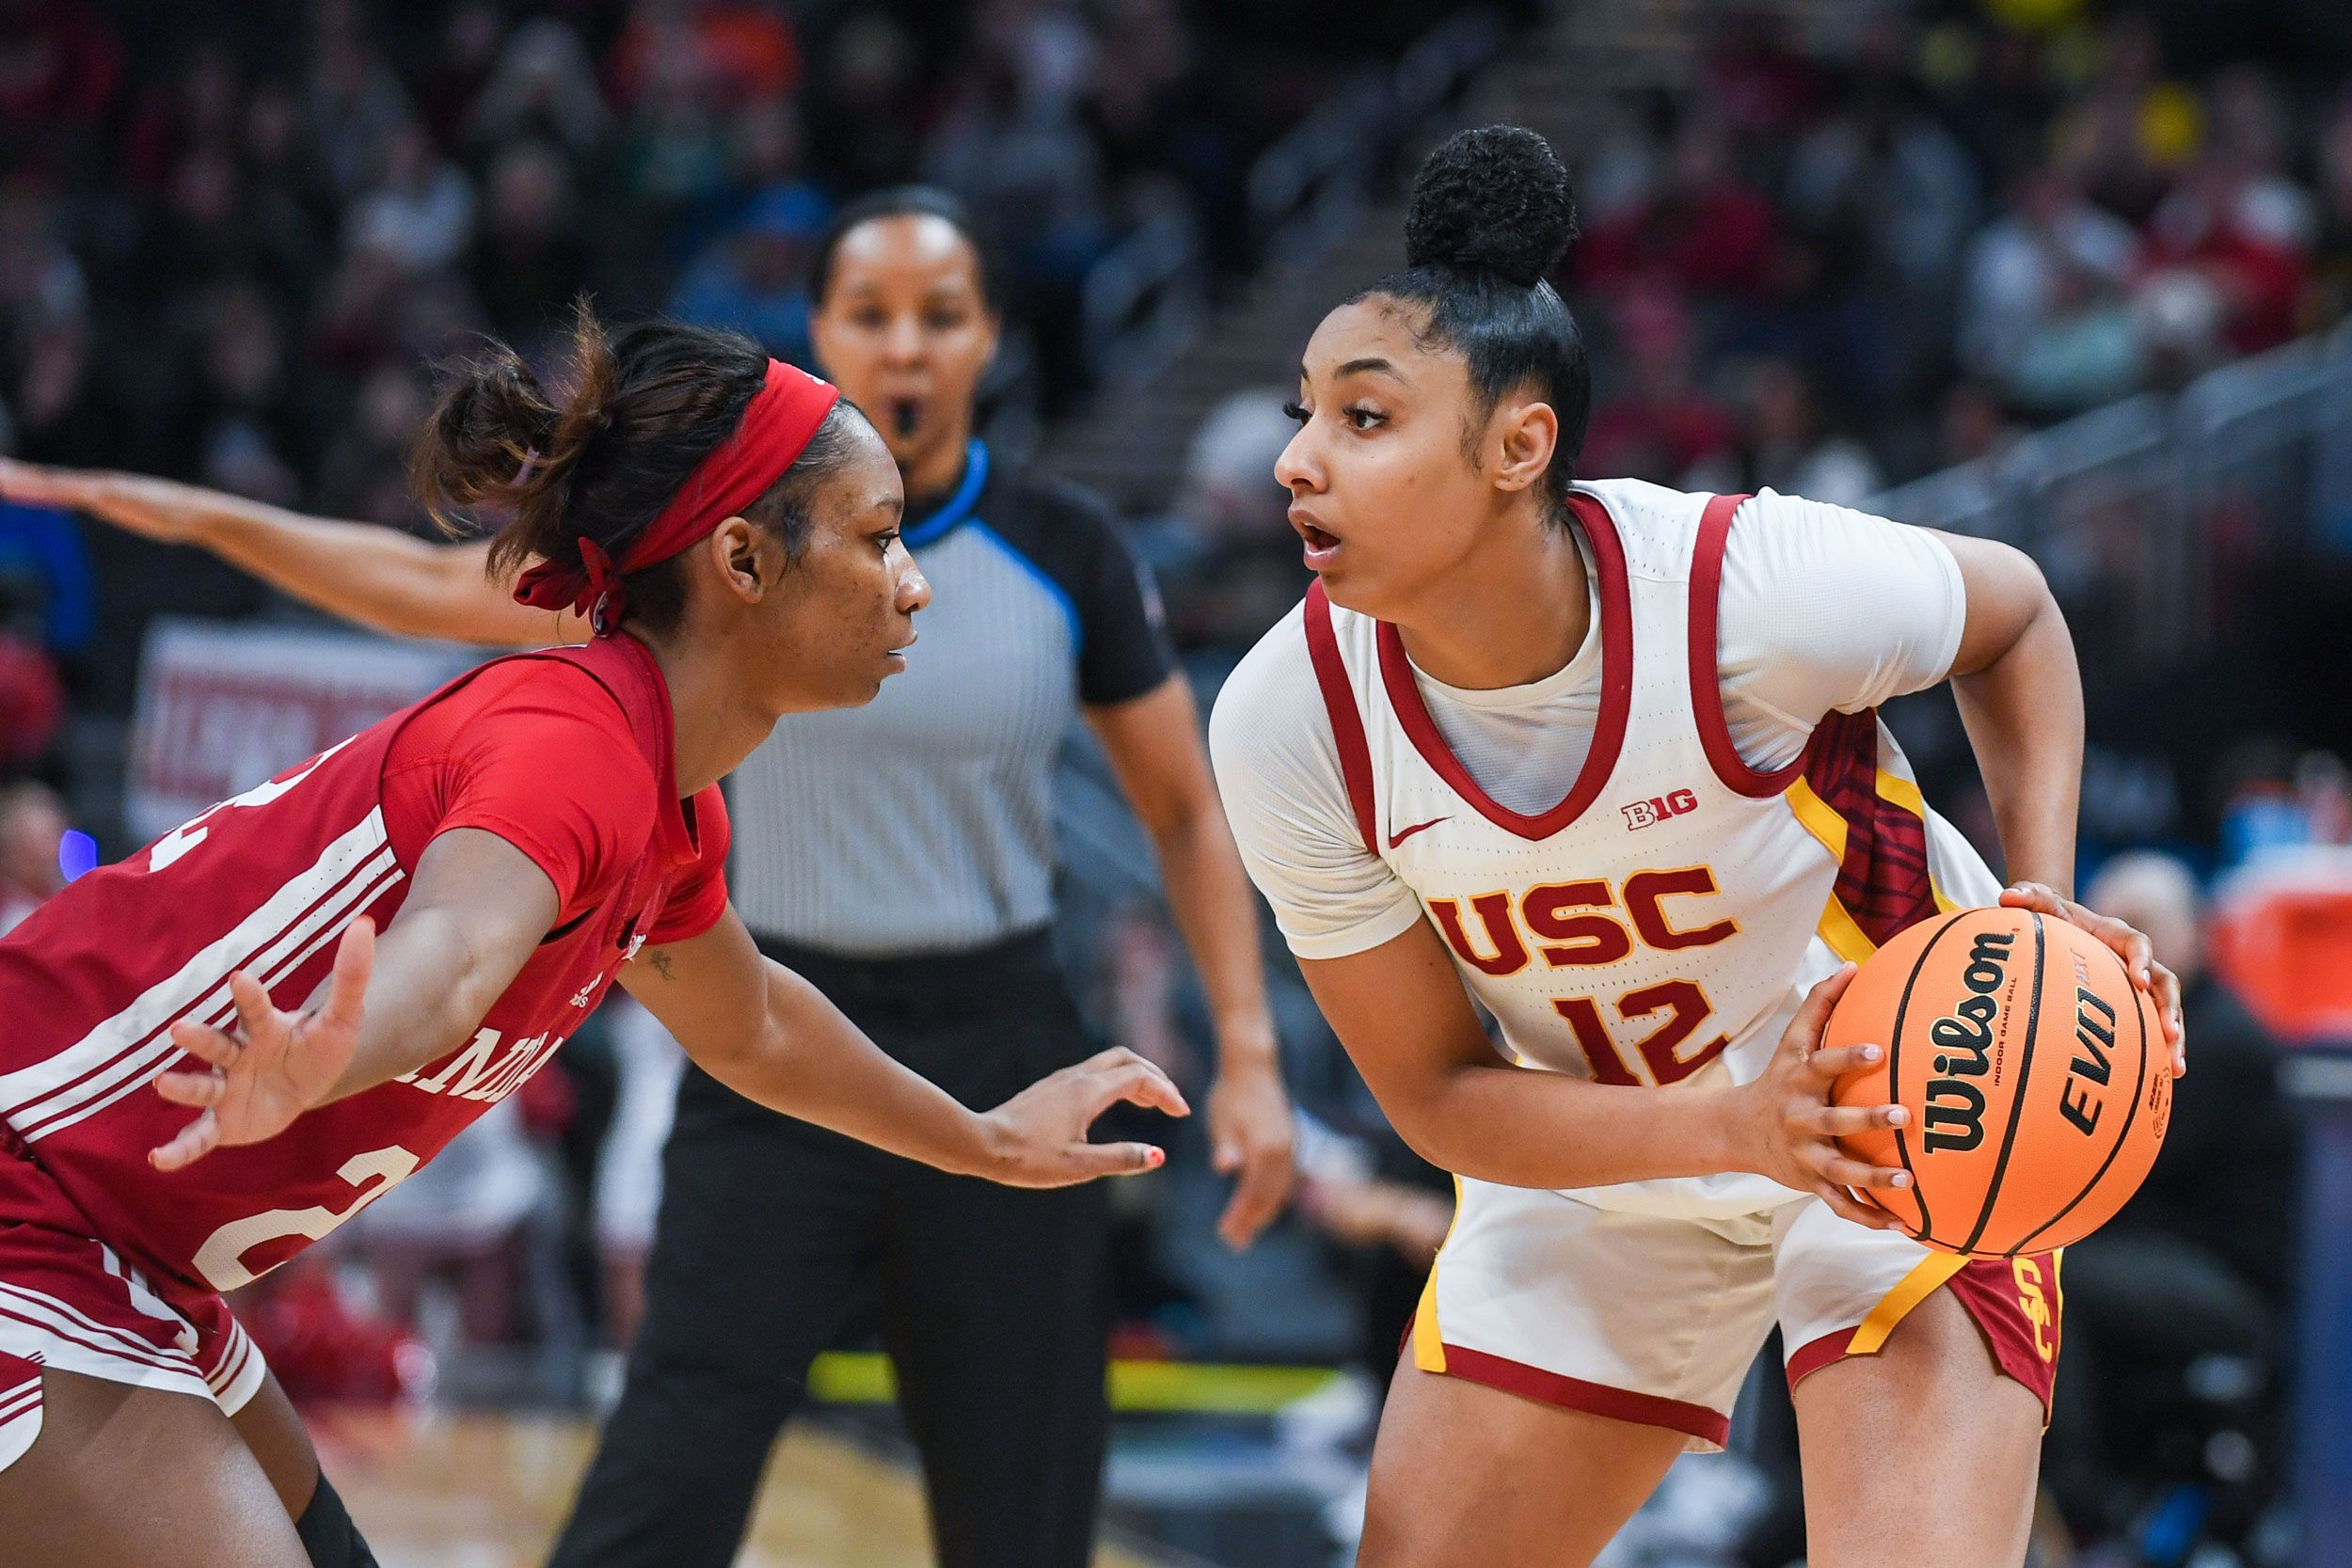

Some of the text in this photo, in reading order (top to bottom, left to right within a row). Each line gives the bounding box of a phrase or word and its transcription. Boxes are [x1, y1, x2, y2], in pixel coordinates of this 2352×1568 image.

[1424, 864, 1742, 977] USC
[1549, 978, 1732, 1087] 12
[1922, 932, 2017, 1155] Wilson
[1994, 977, 2018, 1086] INDOOR GAME BALL
